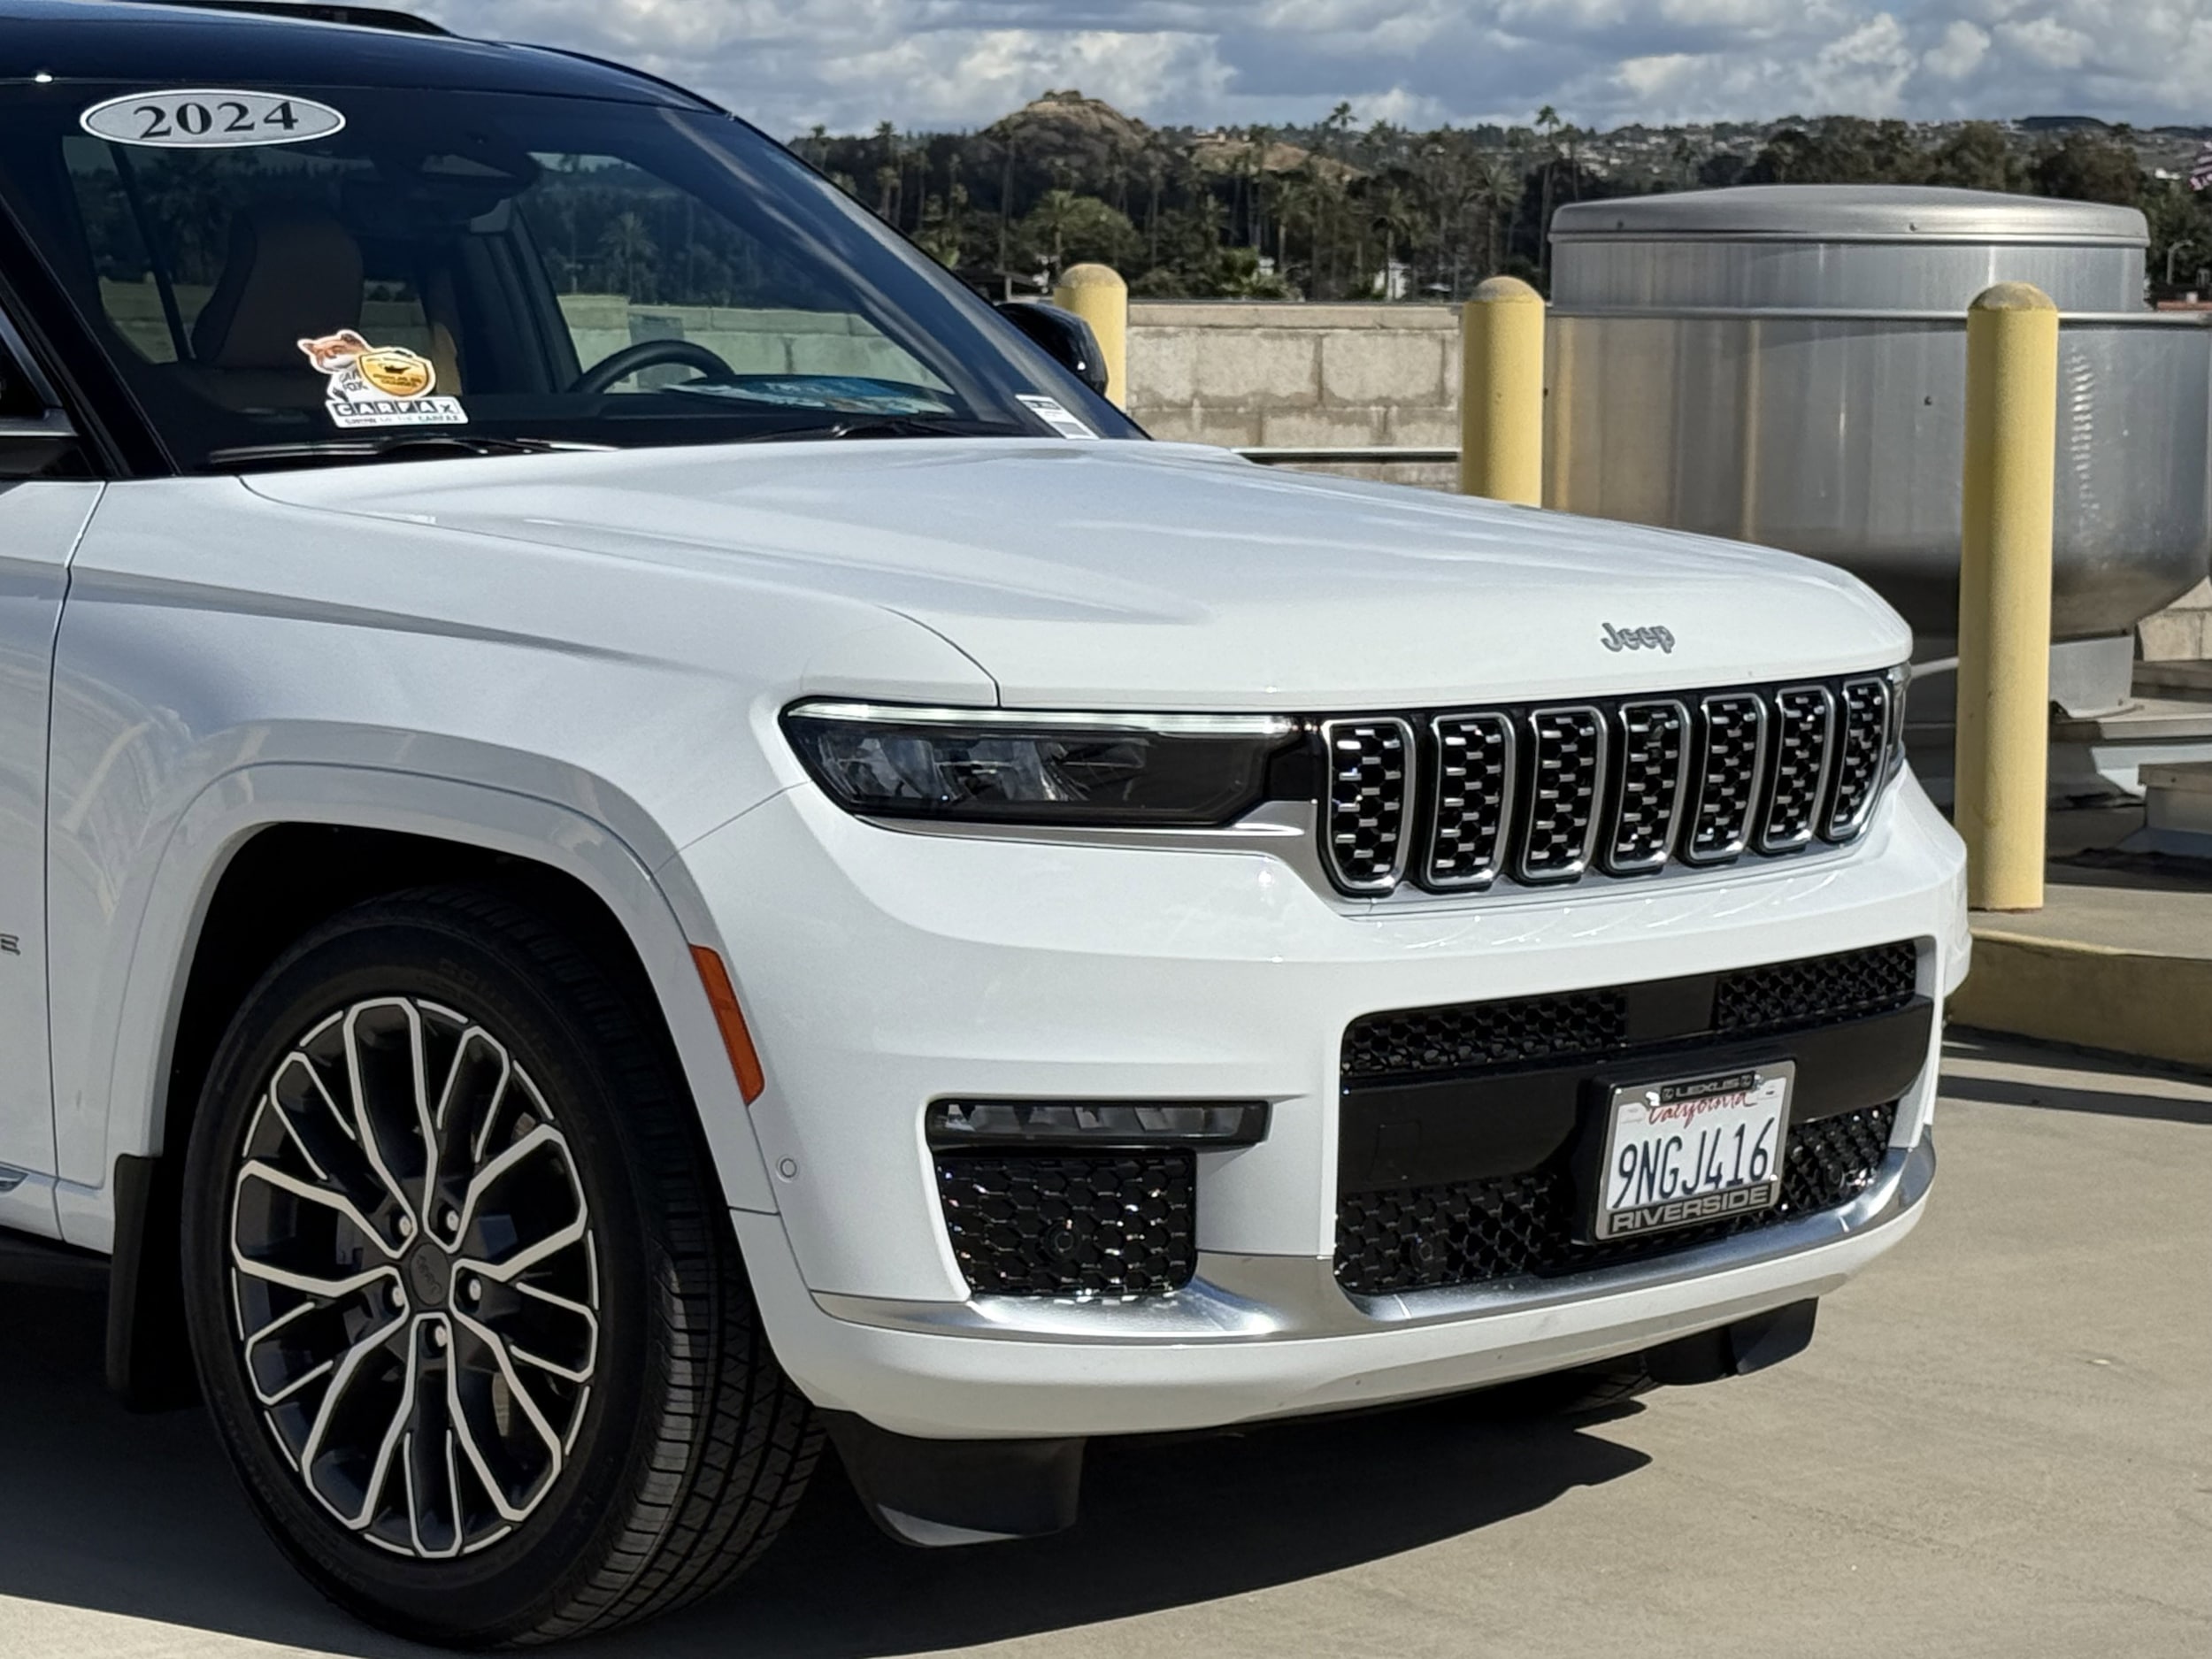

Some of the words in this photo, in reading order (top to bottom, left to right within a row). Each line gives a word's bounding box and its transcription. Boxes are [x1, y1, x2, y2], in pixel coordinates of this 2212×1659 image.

[134, 101, 299, 139] 2024
[334, 400, 457, 417] CARFAX
[1600, 622, 1676, 654] Jeep
[1675, 1077, 1740, 1098] LEXUS
[1612, 1117, 1776, 1209] 9NGJ416
[1611, 1185, 1770, 1233] RIVERSIDE
